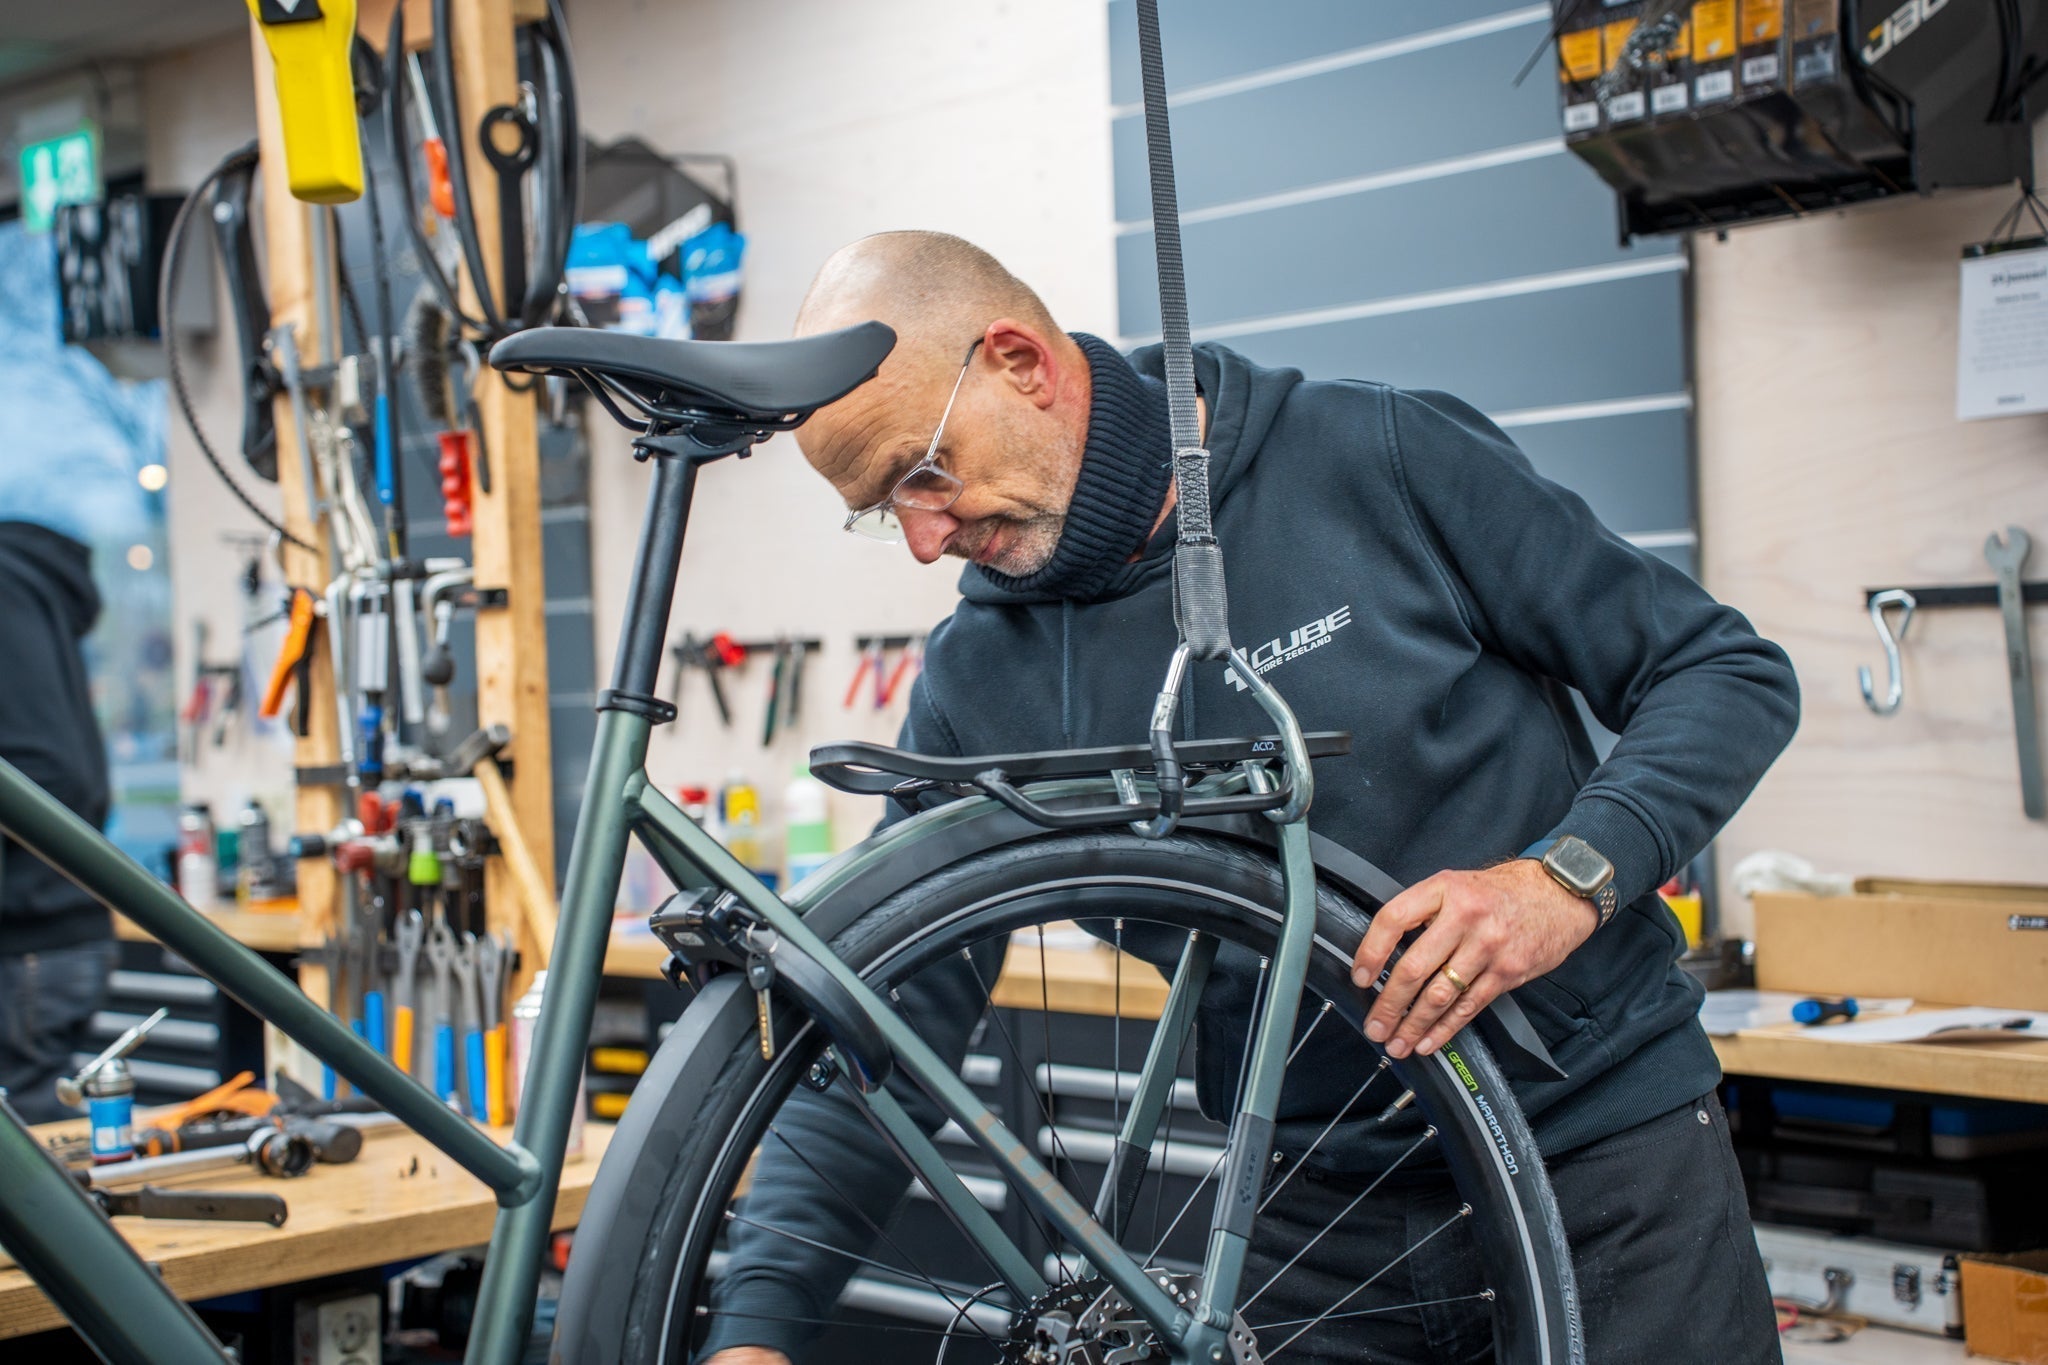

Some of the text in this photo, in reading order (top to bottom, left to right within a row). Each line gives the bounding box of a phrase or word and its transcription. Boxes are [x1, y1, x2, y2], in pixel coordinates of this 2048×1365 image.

[1251, 605, 1351, 669] CUBE
[1285, 634, 1332, 662] ZEELAND
[1447, 1050, 1519, 1176] GREEN MARATHON
